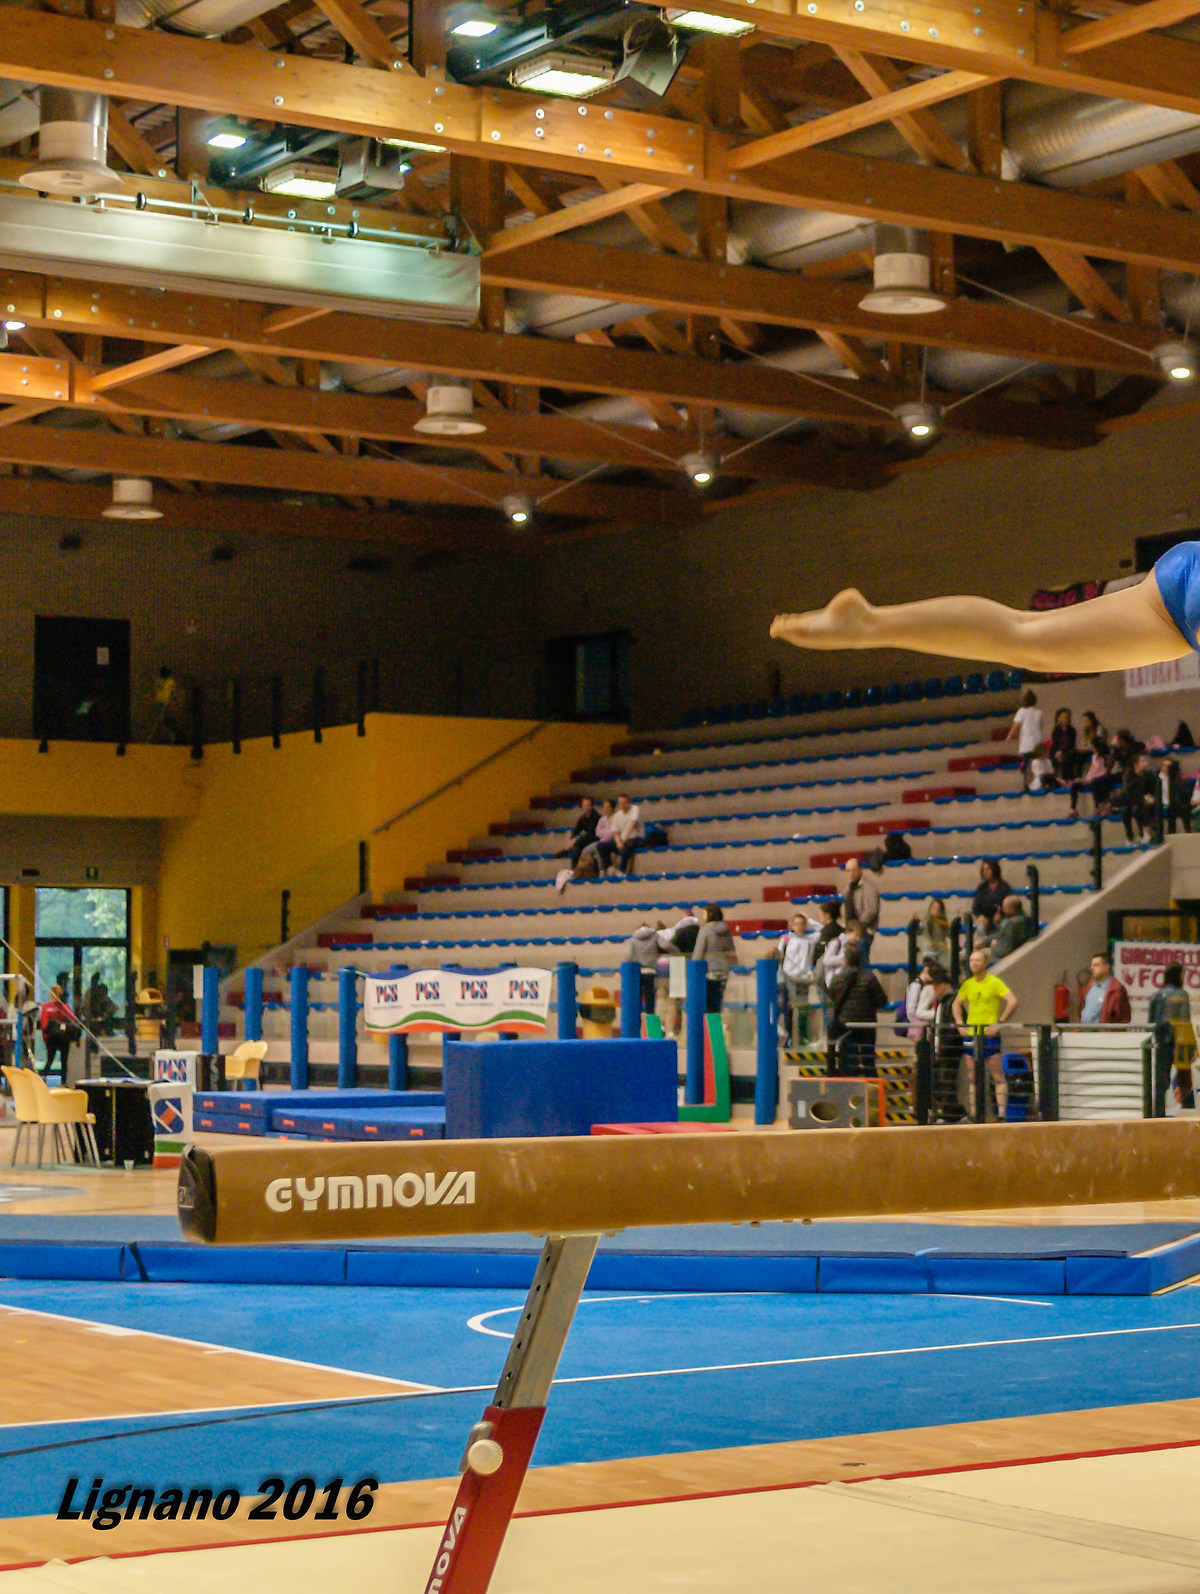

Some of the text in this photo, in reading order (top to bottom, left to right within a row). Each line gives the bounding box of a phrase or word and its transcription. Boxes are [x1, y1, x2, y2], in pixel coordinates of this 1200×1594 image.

[376, 984, 399, 1003] PGS
[415, 981, 440, 1001] PGS
[461, 980, 488, 1000] PGS
[509, 980, 539, 1000] PGS
[265, 1170, 476, 1212] GYMNOVA
